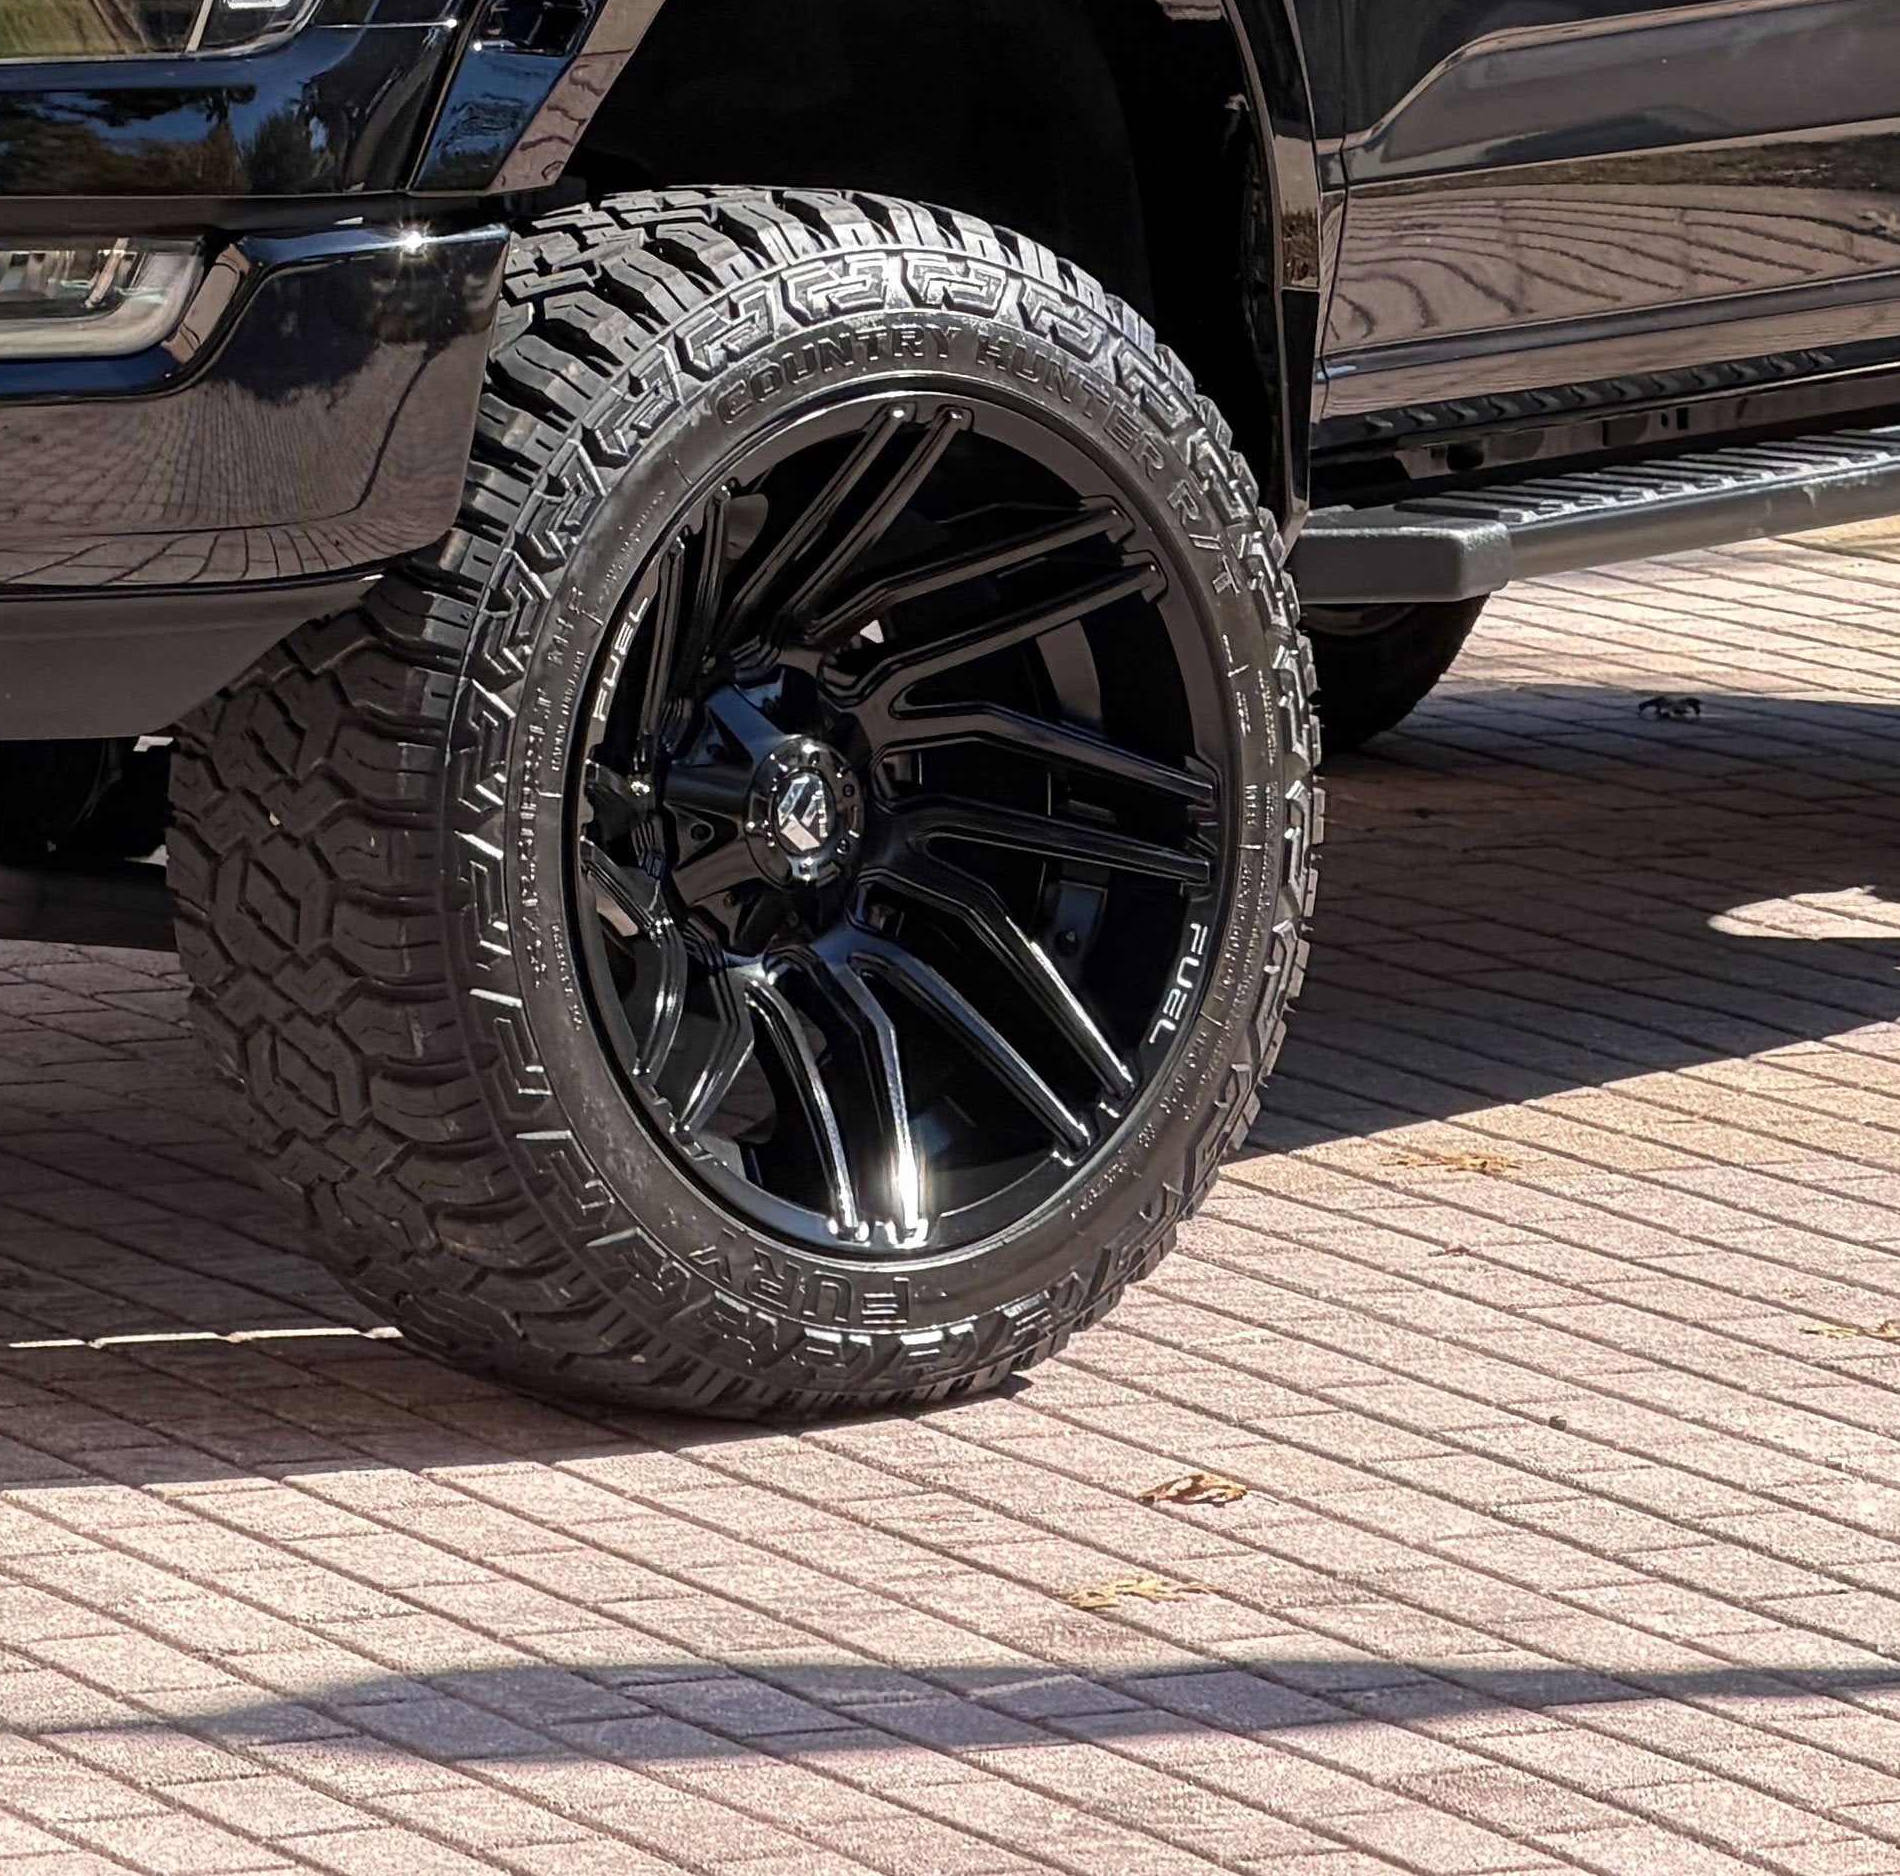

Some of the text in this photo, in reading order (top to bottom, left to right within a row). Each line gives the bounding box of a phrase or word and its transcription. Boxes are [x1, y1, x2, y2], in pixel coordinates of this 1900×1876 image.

[716, 322, 1243, 597] COUNTRY HUNTER R/T
[591, 597, 649, 722] FUEL
[1148, 922, 1209, 1045] FUEL
[688, 1227, 911, 1325] FURY
